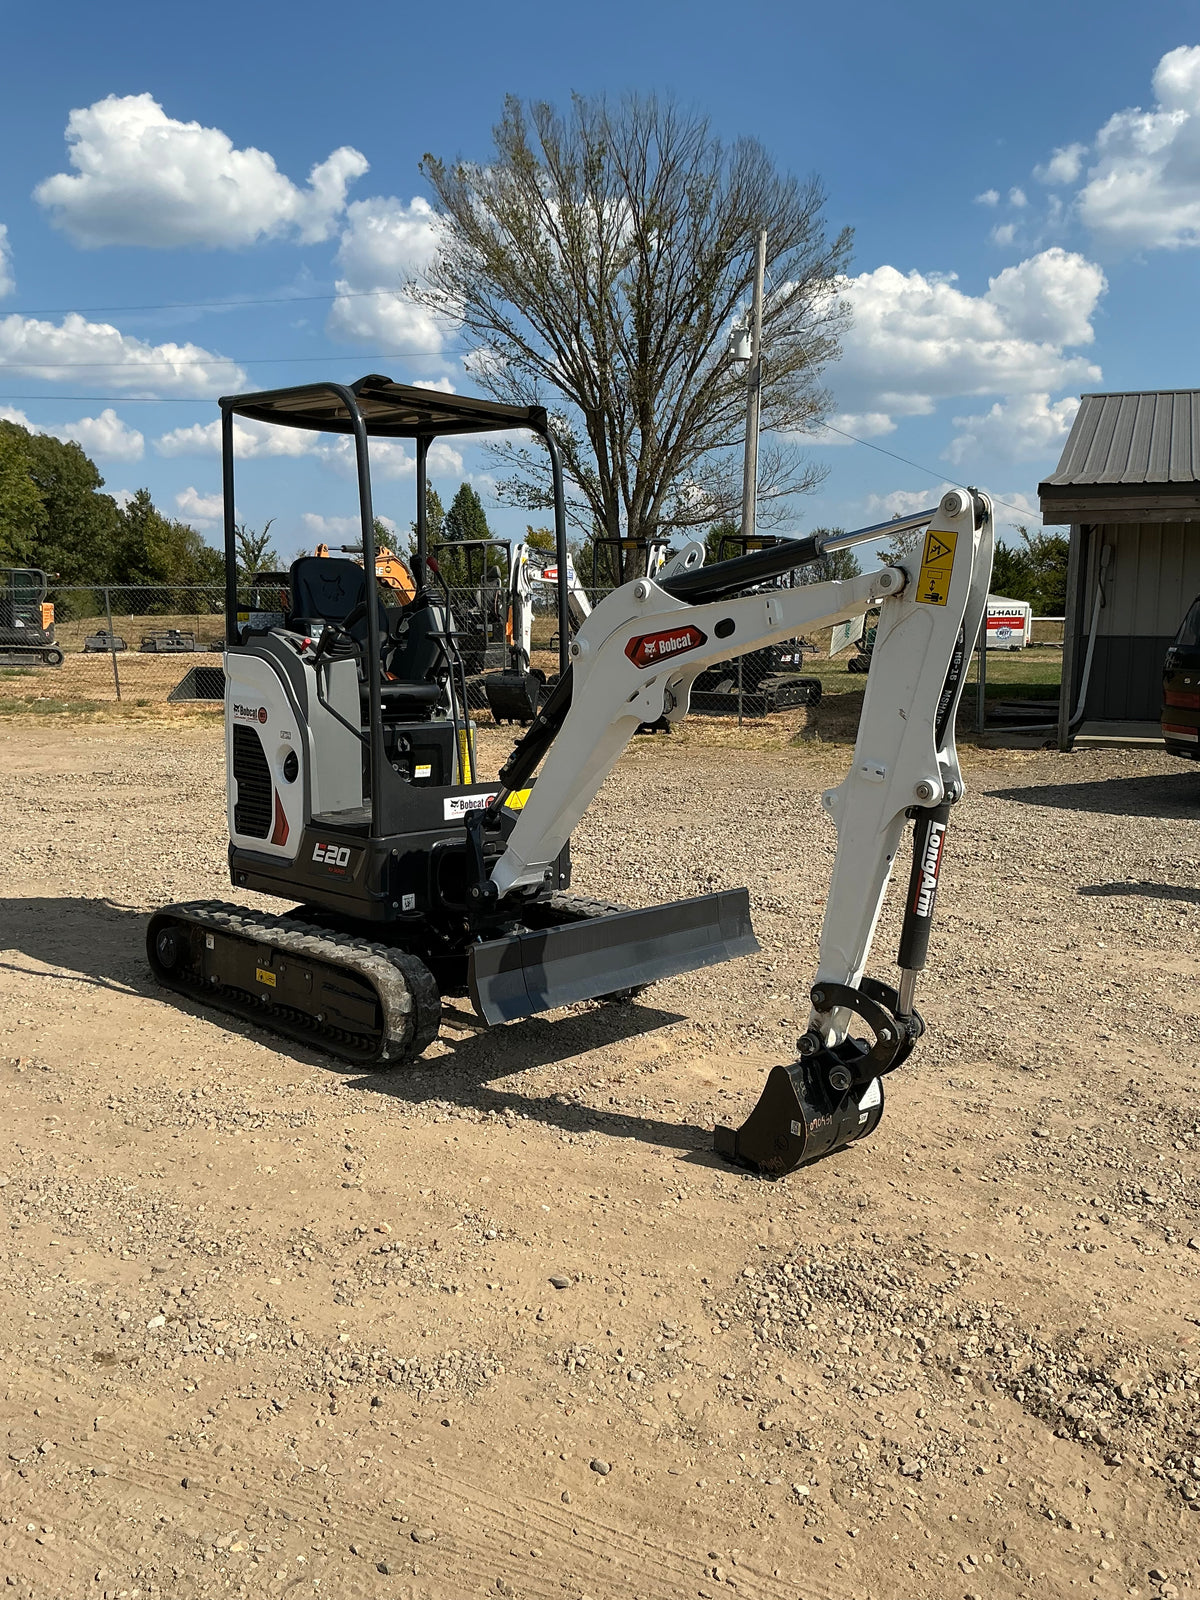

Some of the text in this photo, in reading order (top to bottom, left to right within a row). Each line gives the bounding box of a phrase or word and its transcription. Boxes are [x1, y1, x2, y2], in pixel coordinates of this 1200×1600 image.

[658, 633, 692, 654] Bobcat
[460, 799, 485, 810] Bobcat
[312, 842, 351, 867] E20
[916, 821, 946, 918] LongArm
